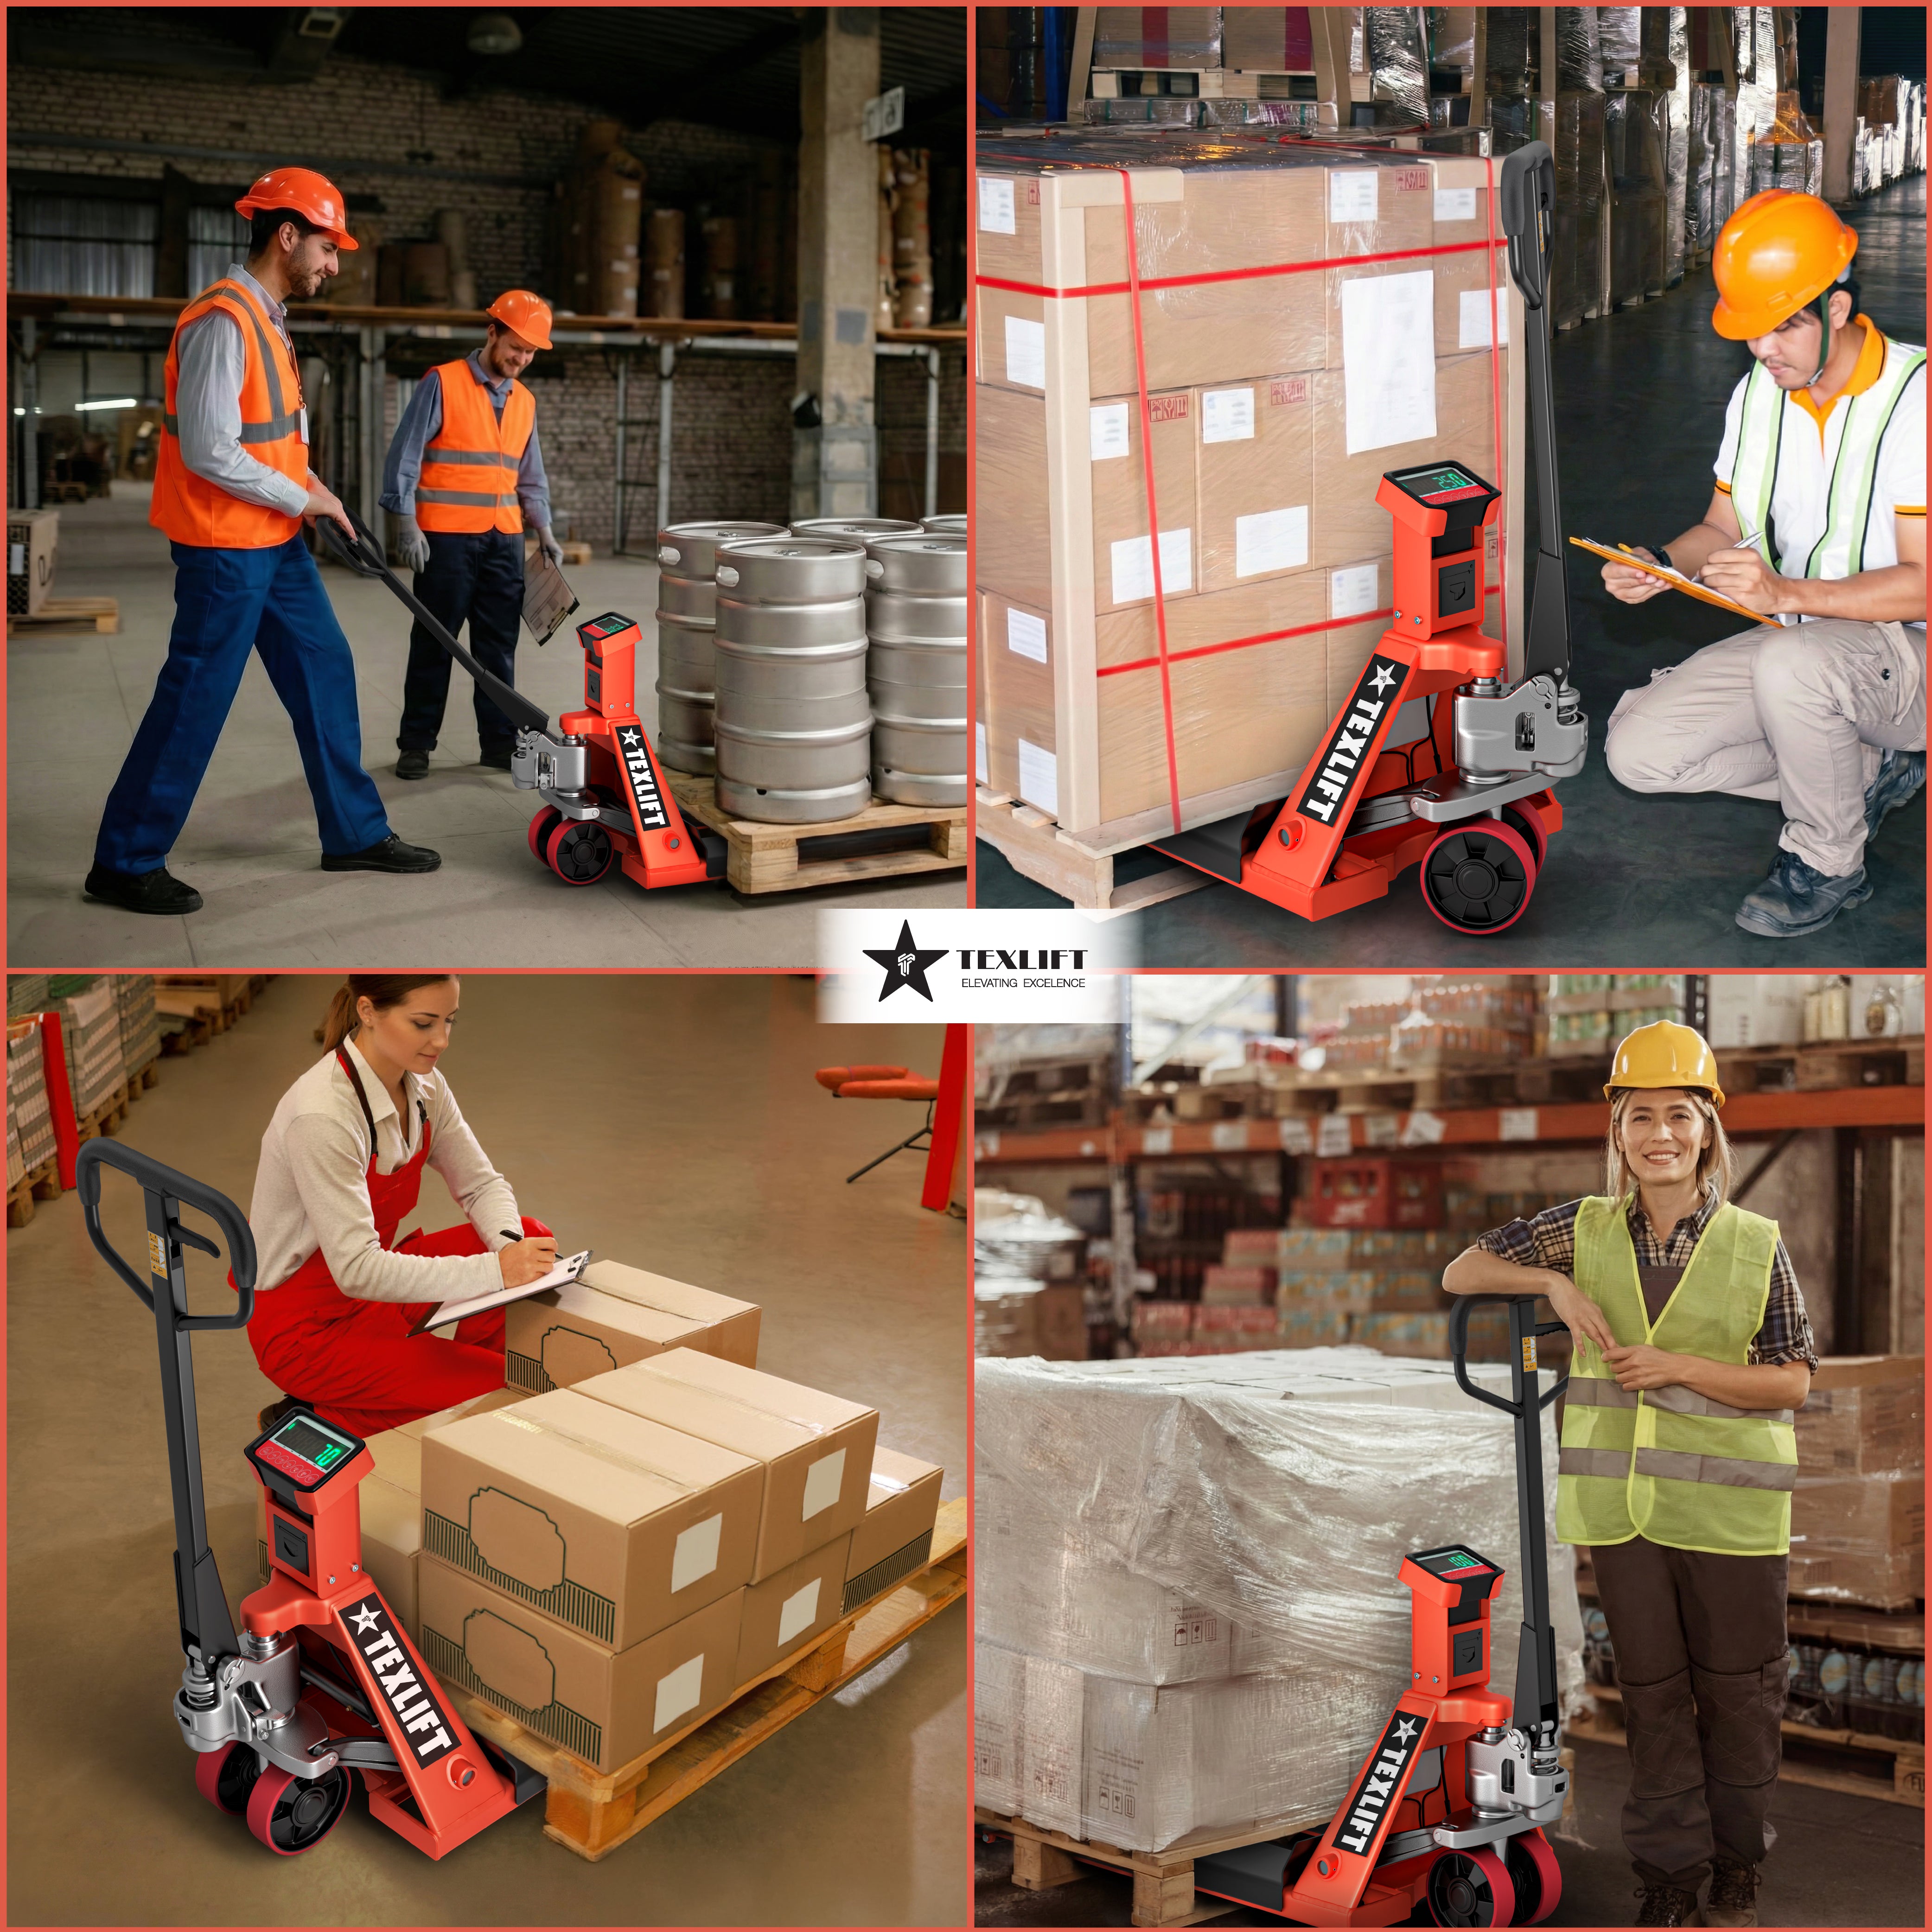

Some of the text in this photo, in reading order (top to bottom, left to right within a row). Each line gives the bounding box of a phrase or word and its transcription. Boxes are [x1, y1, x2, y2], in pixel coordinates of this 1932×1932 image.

[1432, 473, 1467, 489] 250
[625, 748, 666, 825] TEXLIFT
[1306, 699, 1384, 822] TEXLIFT
[1448, 1555, 1475, 1567] 100
[364, 1630, 453, 1756] TEXLIFT
[1341, 1748, 1407, 1853] TEXLIFT
